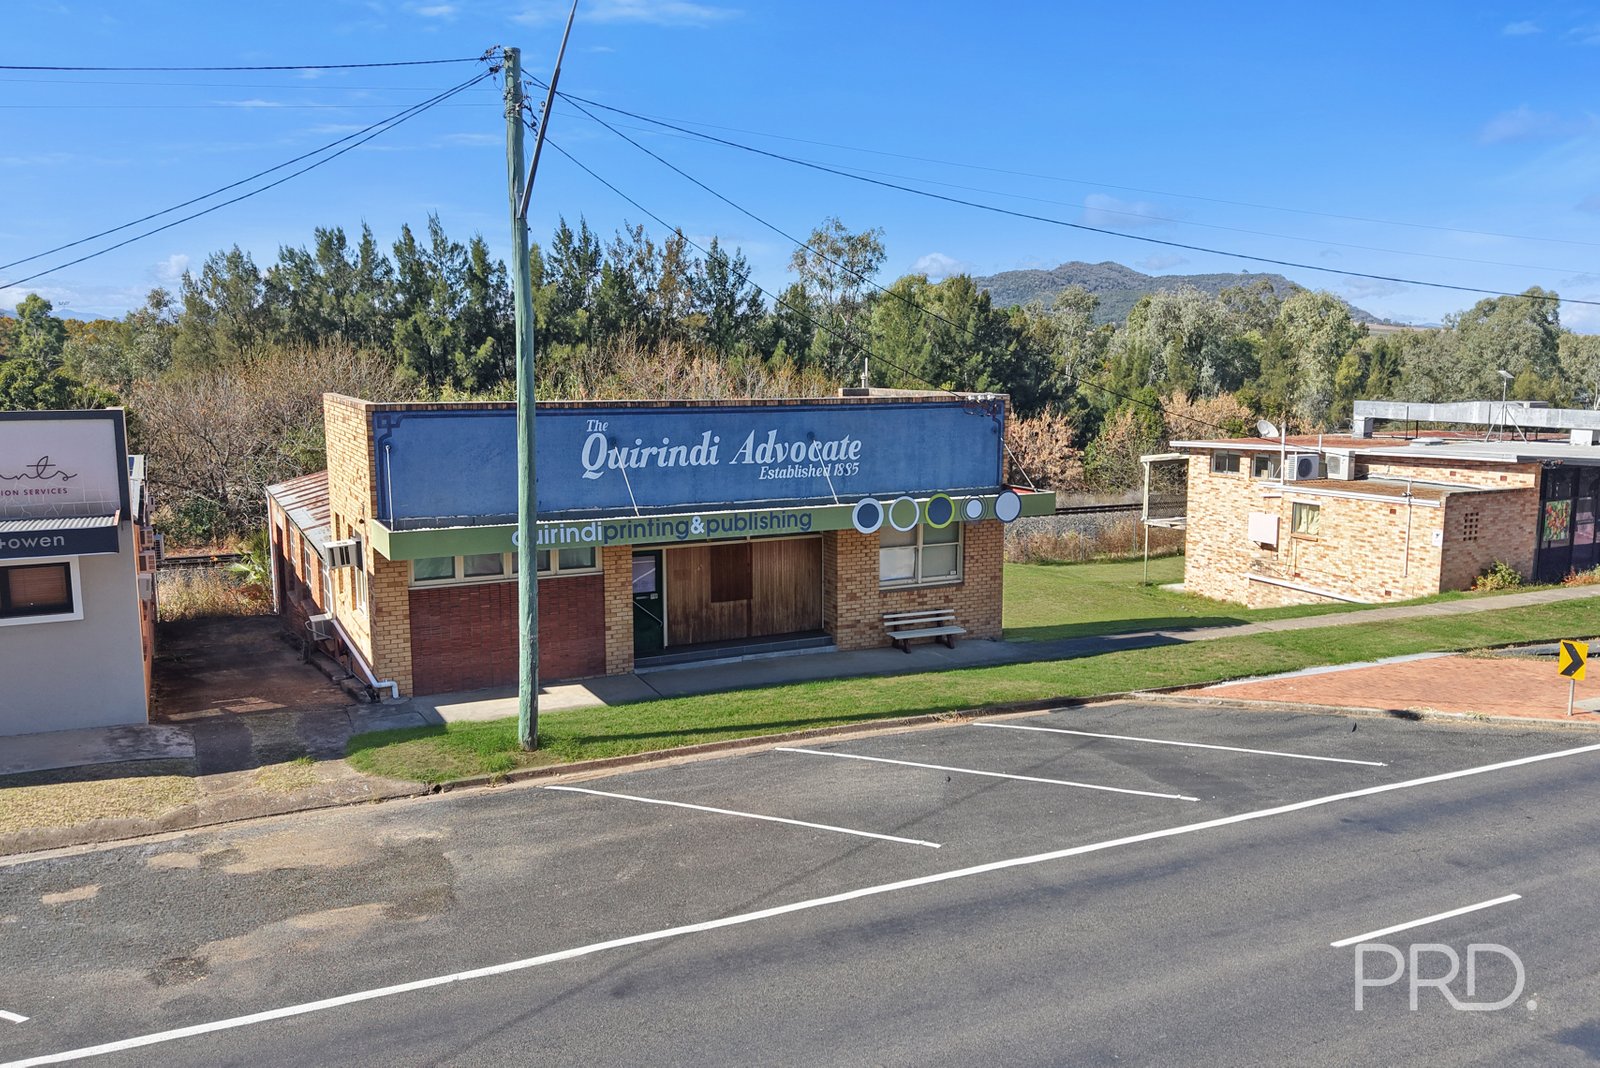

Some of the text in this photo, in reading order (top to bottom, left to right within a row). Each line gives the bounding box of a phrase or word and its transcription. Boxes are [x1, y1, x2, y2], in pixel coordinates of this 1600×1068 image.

[586, 419, 608, 432] The
[581, 429, 862, 479] Quirindi Advocate
[759, 464, 831, 480] Established
[23, 487, 68, 496] SERVICES
